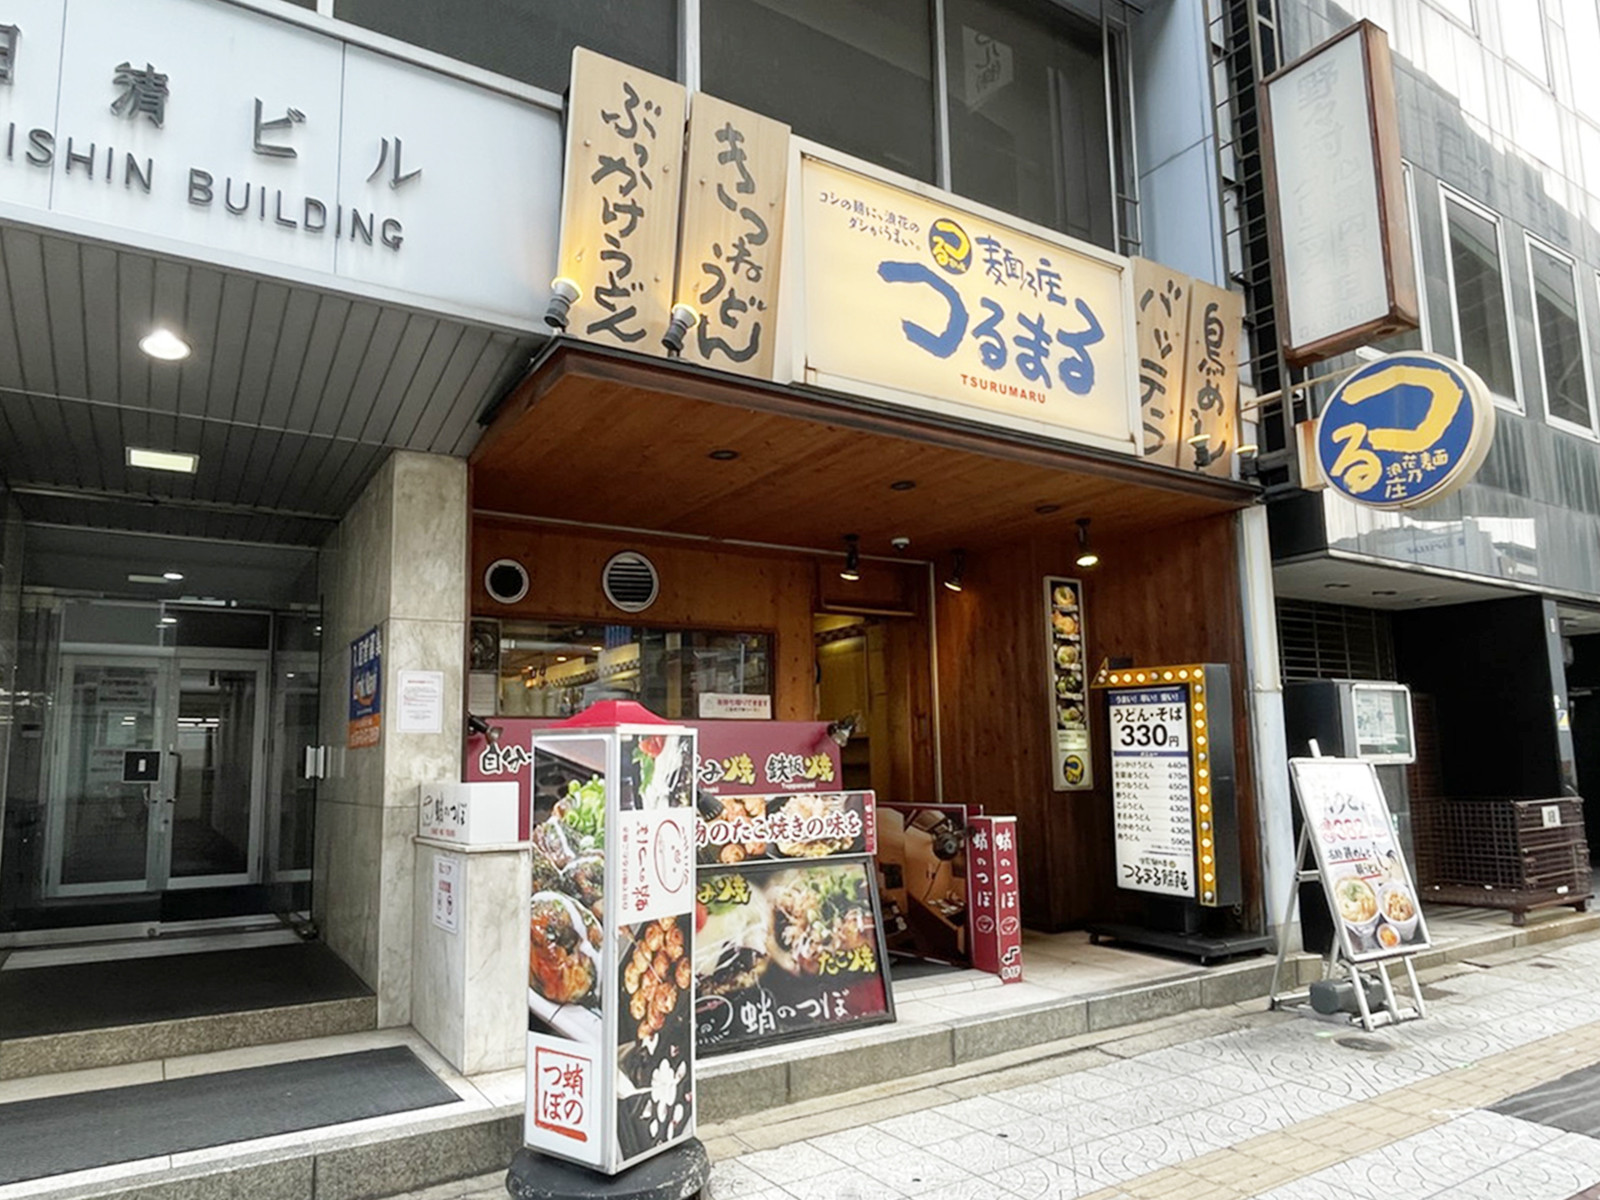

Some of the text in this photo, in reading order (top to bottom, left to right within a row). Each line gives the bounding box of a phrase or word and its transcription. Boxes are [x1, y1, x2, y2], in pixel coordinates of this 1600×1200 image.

[188, 167, 405, 251] BUILDING
[585, 81, 662, 343] ぶっかけうどん
[696, 122, 768, 363] きつねうどん
[877, 260, 1106, 395] つるまる
[960, 373, 1046, 404] TSURUMARU
[1139, 279, 1182, 456] バッテラ
[1329, 364, 1464, 494] つる
[1113, 705, 1184, 724] うどん・そば
[1120, 723, 1180, 747] 330円
[480, 744, 835, 785] 自分 み焼 鉄板焼
[819, 943, 877, 975] たこ焼
[740, 987, 850, 1035] 蛸のつぼ
